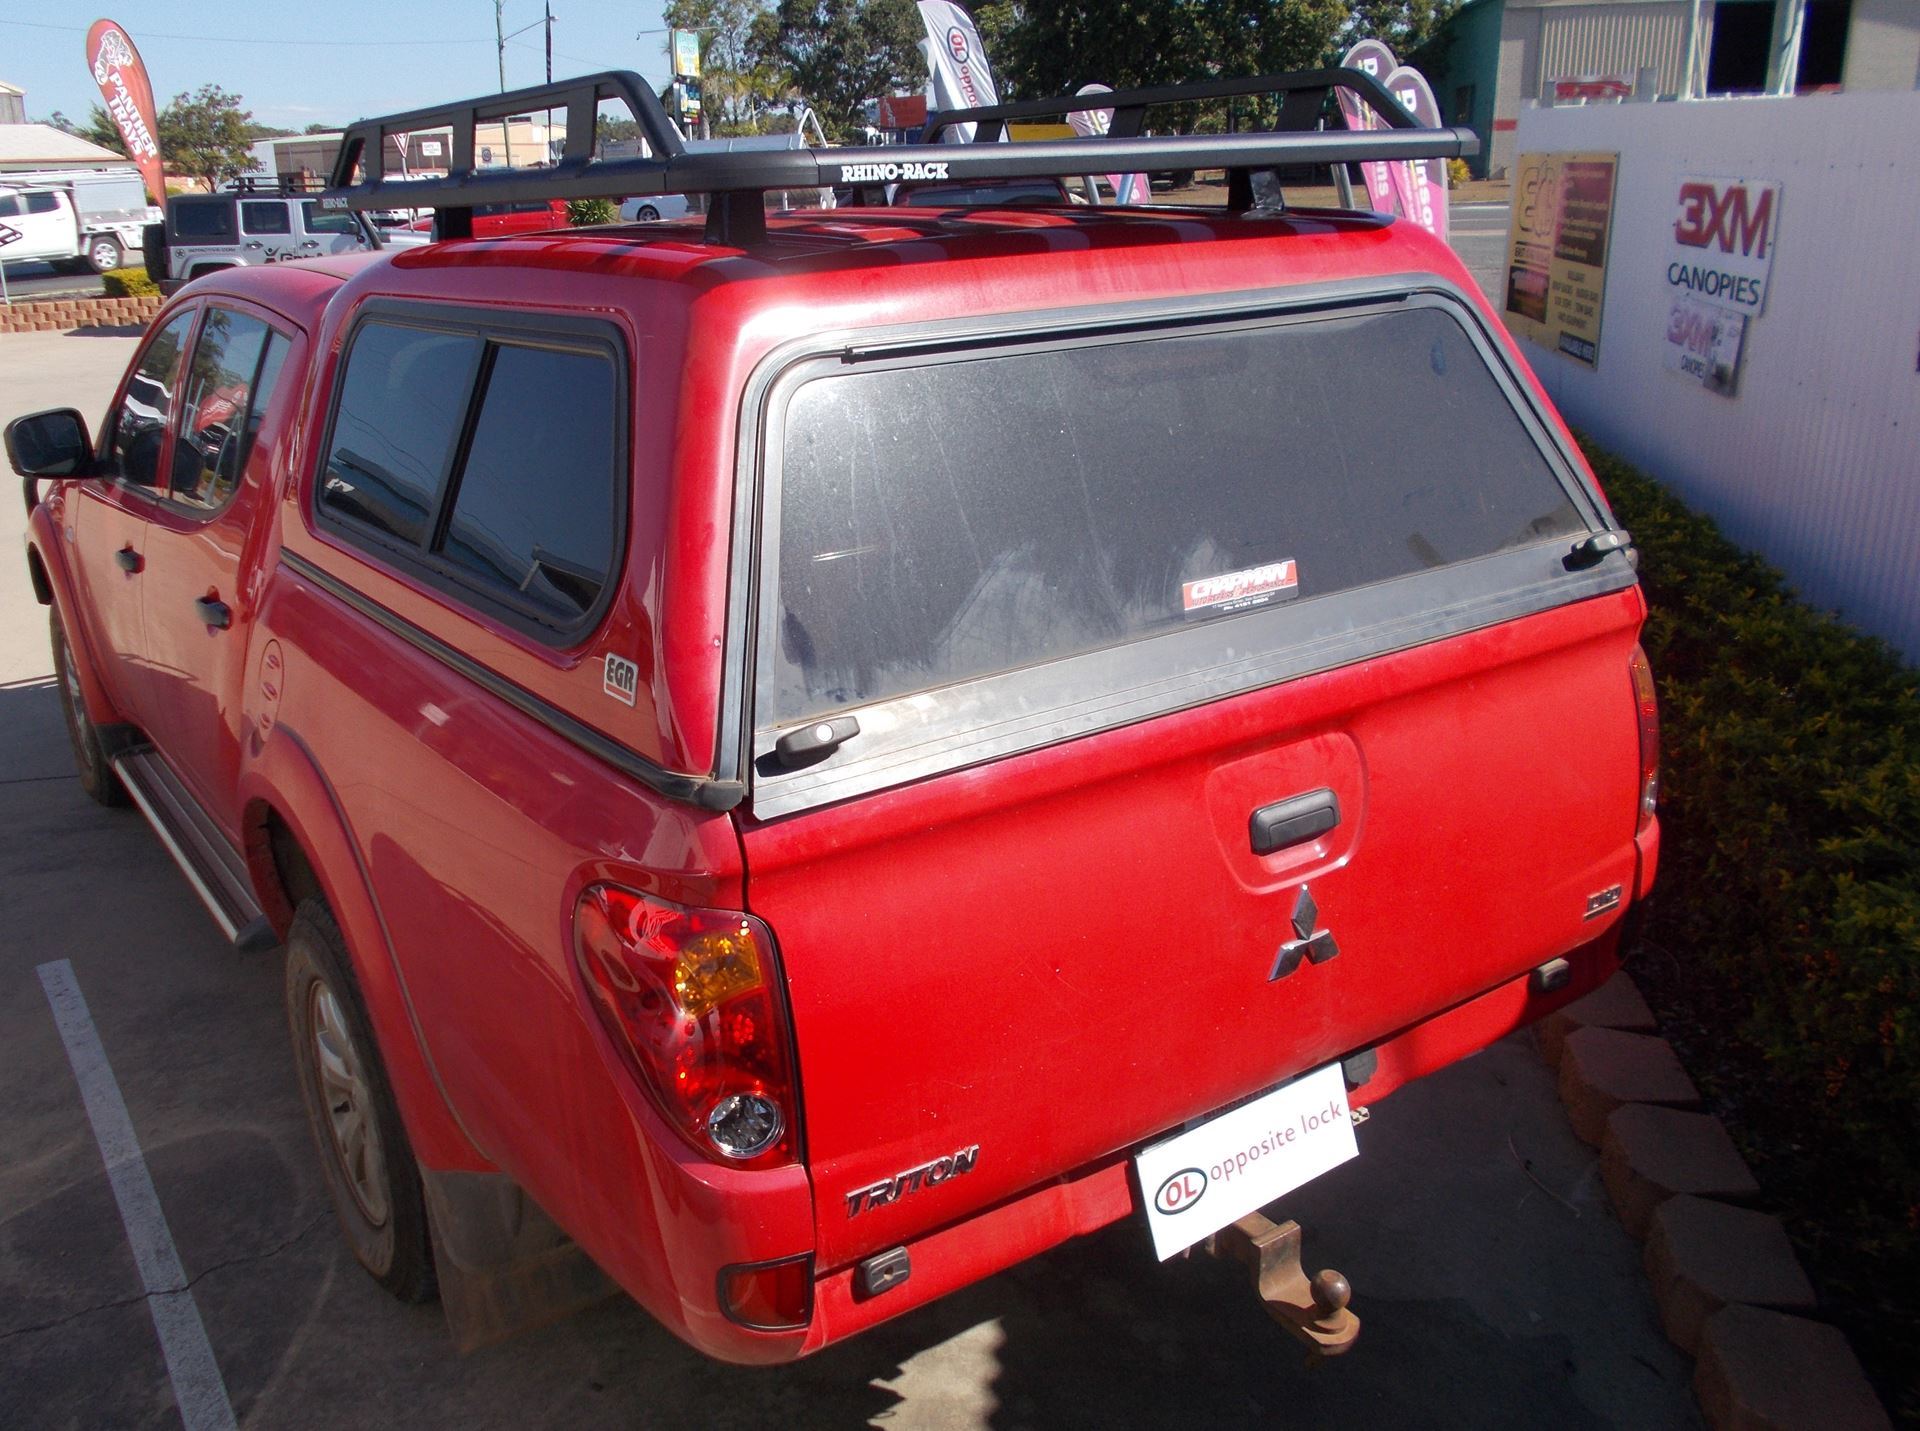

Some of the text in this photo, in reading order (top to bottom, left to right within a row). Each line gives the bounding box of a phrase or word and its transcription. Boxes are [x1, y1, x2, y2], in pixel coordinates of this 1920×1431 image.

[108, 94, 144, 156] TRAYS
[109, 71, 158, 158] PANTHER
[841, 163, 948, 182] RHINO-RACK
[1675, 182, 1774, 259] 3XM
[1668, 263, 1760, 306] CANOPIES
[1190, 562, 1288, 600] CHAPMAN
[606, 657, 635, 692] EGR
[845, 1143, 980, 1218] TRITON
[1166, 1176, 1198, 1207] OL
[1210, 1127, 1296, 1181] opposite
[1300, 1101, 1342, 1134] lock
